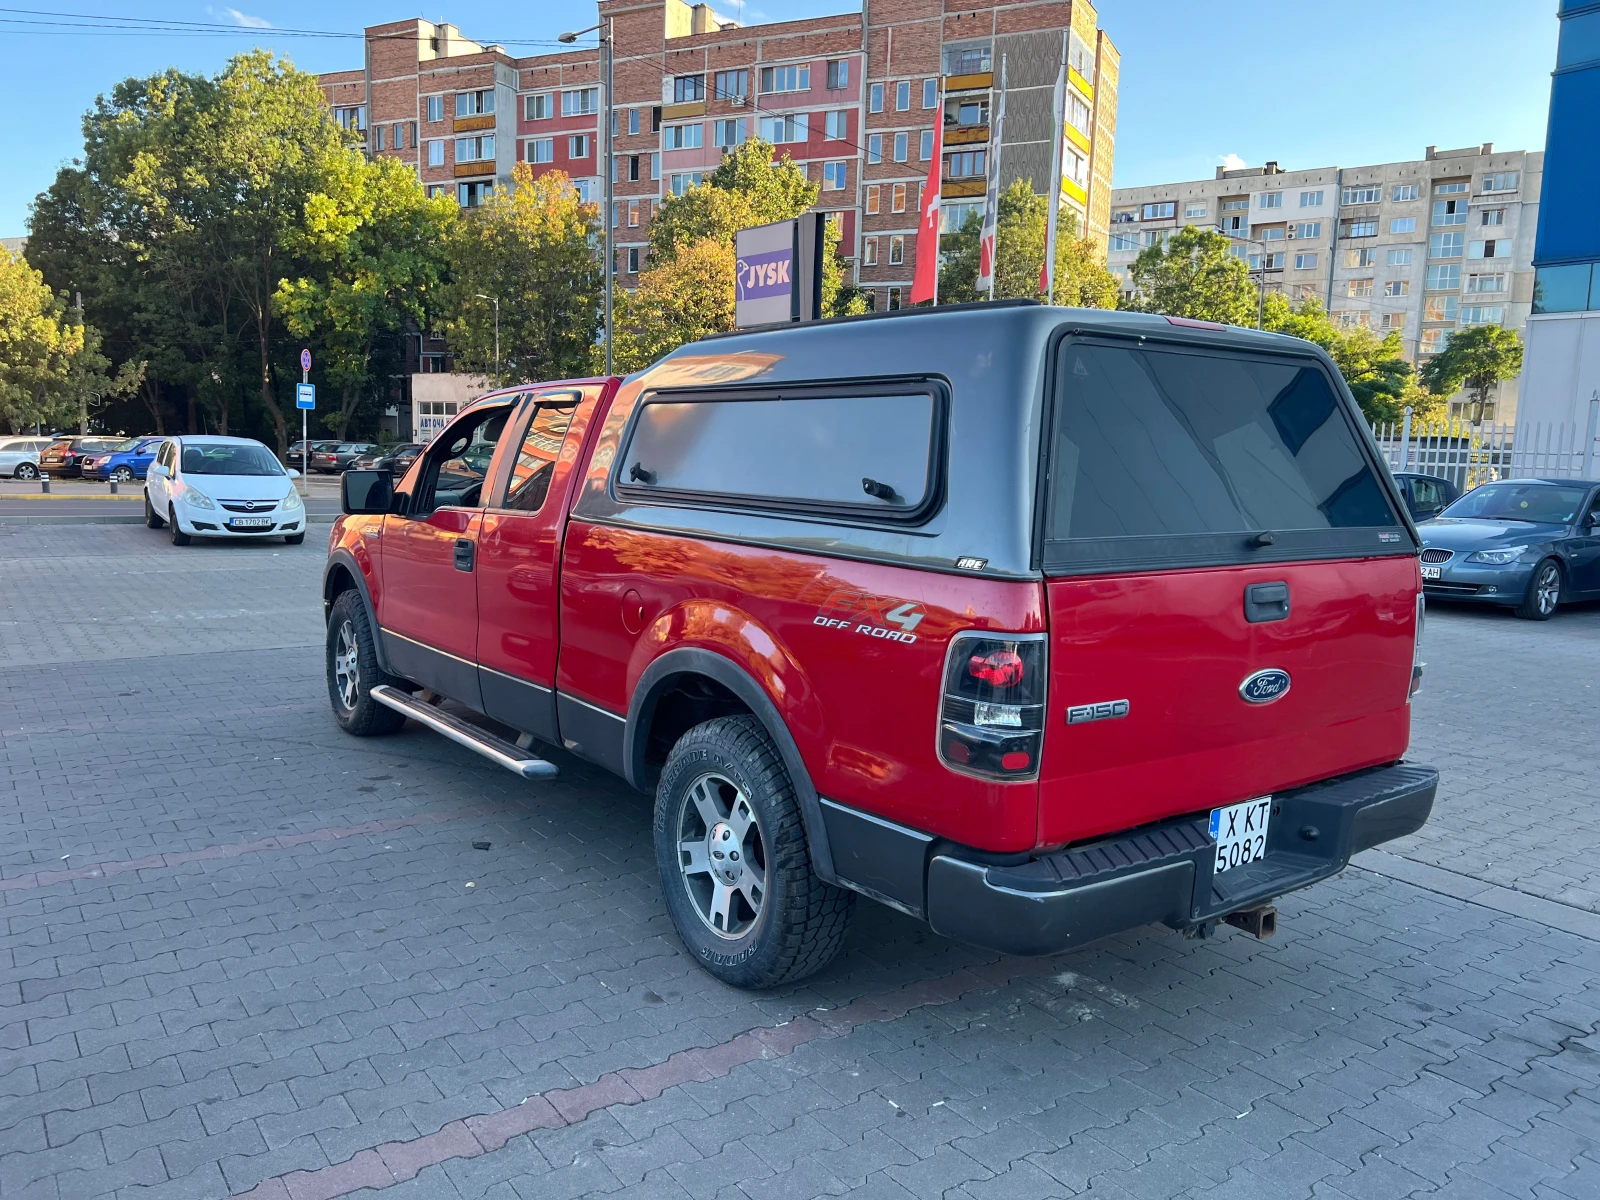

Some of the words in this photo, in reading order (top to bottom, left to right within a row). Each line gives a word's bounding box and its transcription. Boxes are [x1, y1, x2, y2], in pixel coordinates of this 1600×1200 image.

[746, 259, 791, 289] JYSK
[818, 589, 927, 631] FX4
[813, 615, 851, 630] OFF
[855, 623, 917, 644] ROAD
[1253, 676, 1281, 696] Ford
[1225, 809, 1239, 839] X
[1244, 801, 1270, 833] KT
[1216, 834, 1265, 873] 5082
